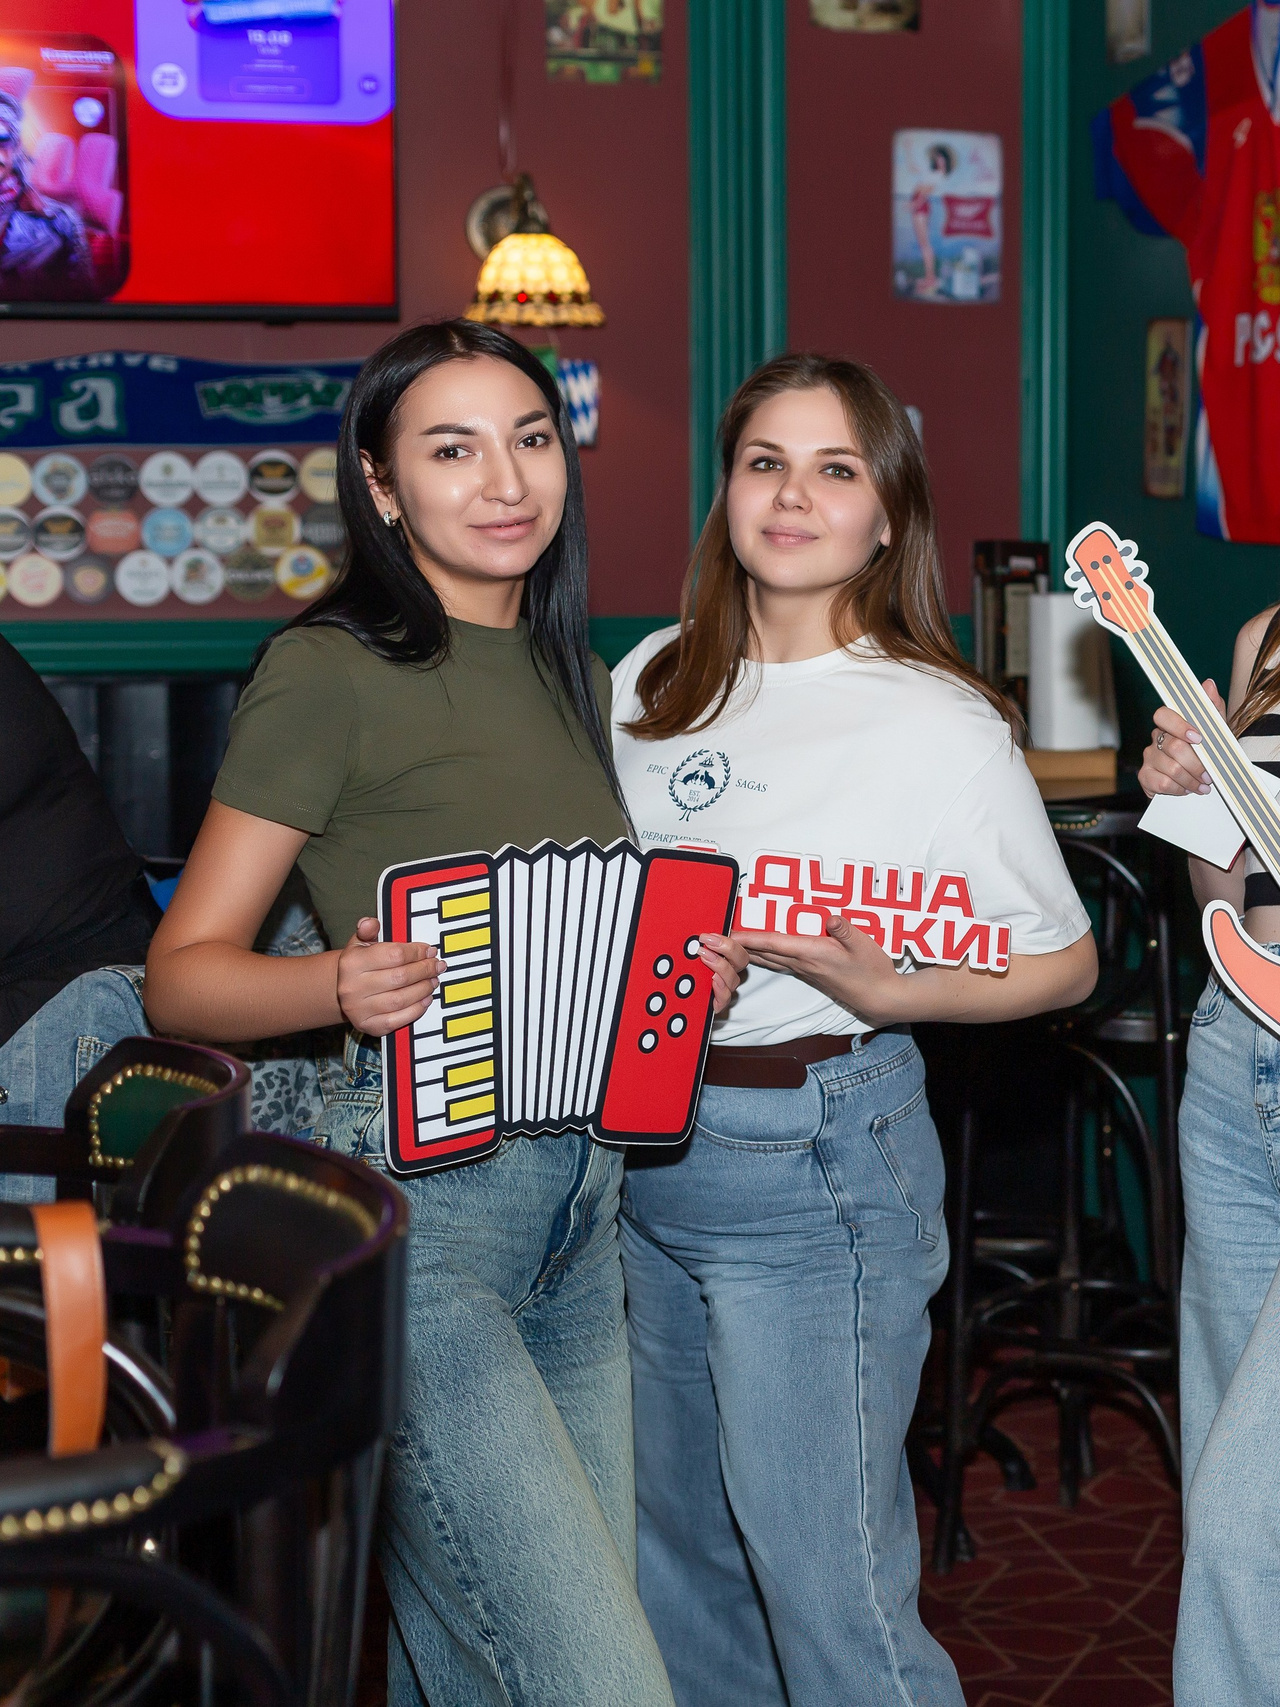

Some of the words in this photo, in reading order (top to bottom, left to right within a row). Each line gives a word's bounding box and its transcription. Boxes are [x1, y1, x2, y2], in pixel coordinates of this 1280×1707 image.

[646, 763, 668, 775] EPIC
[735, 778, 768, 793] SAGAS
[748, 854, 976, 918] ДУША
